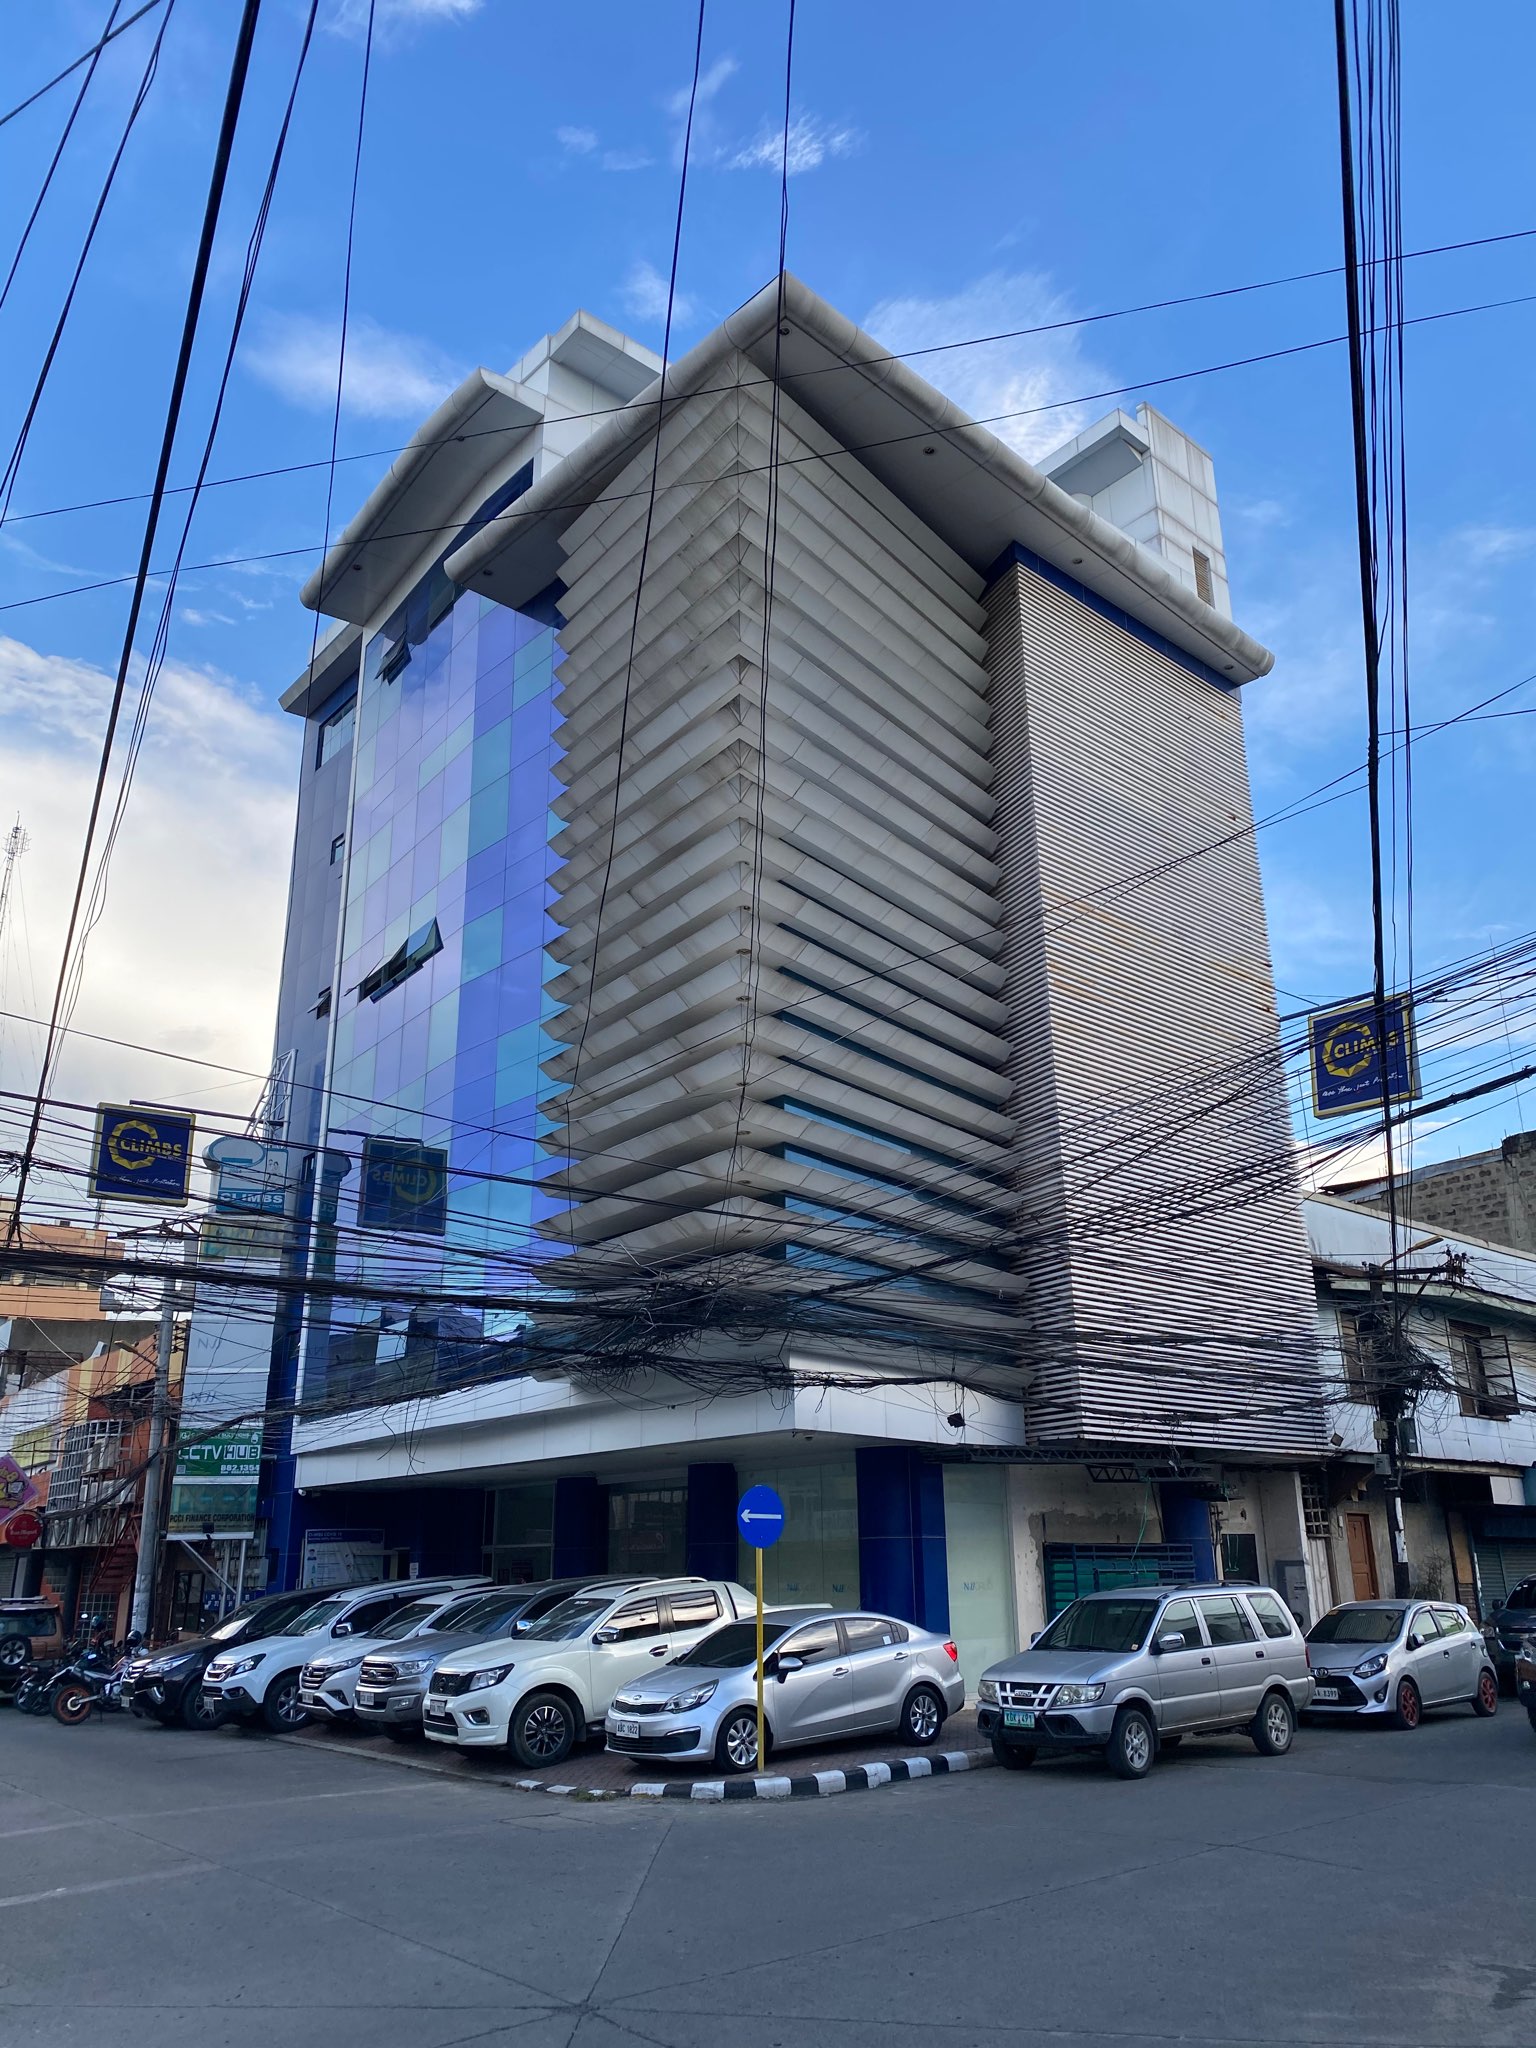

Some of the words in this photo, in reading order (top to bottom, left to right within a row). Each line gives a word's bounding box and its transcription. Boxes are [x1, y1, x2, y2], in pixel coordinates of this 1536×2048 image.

[1334, 1030, 1399, 1059] CLIMS
[120, 1138, 182, 1156] CLIMBS
[178, 1445, 222, 1460] CCTV
[223, 1445, 261, 1460] HUB
[185, 1514, 211, 1523] FINANCE
